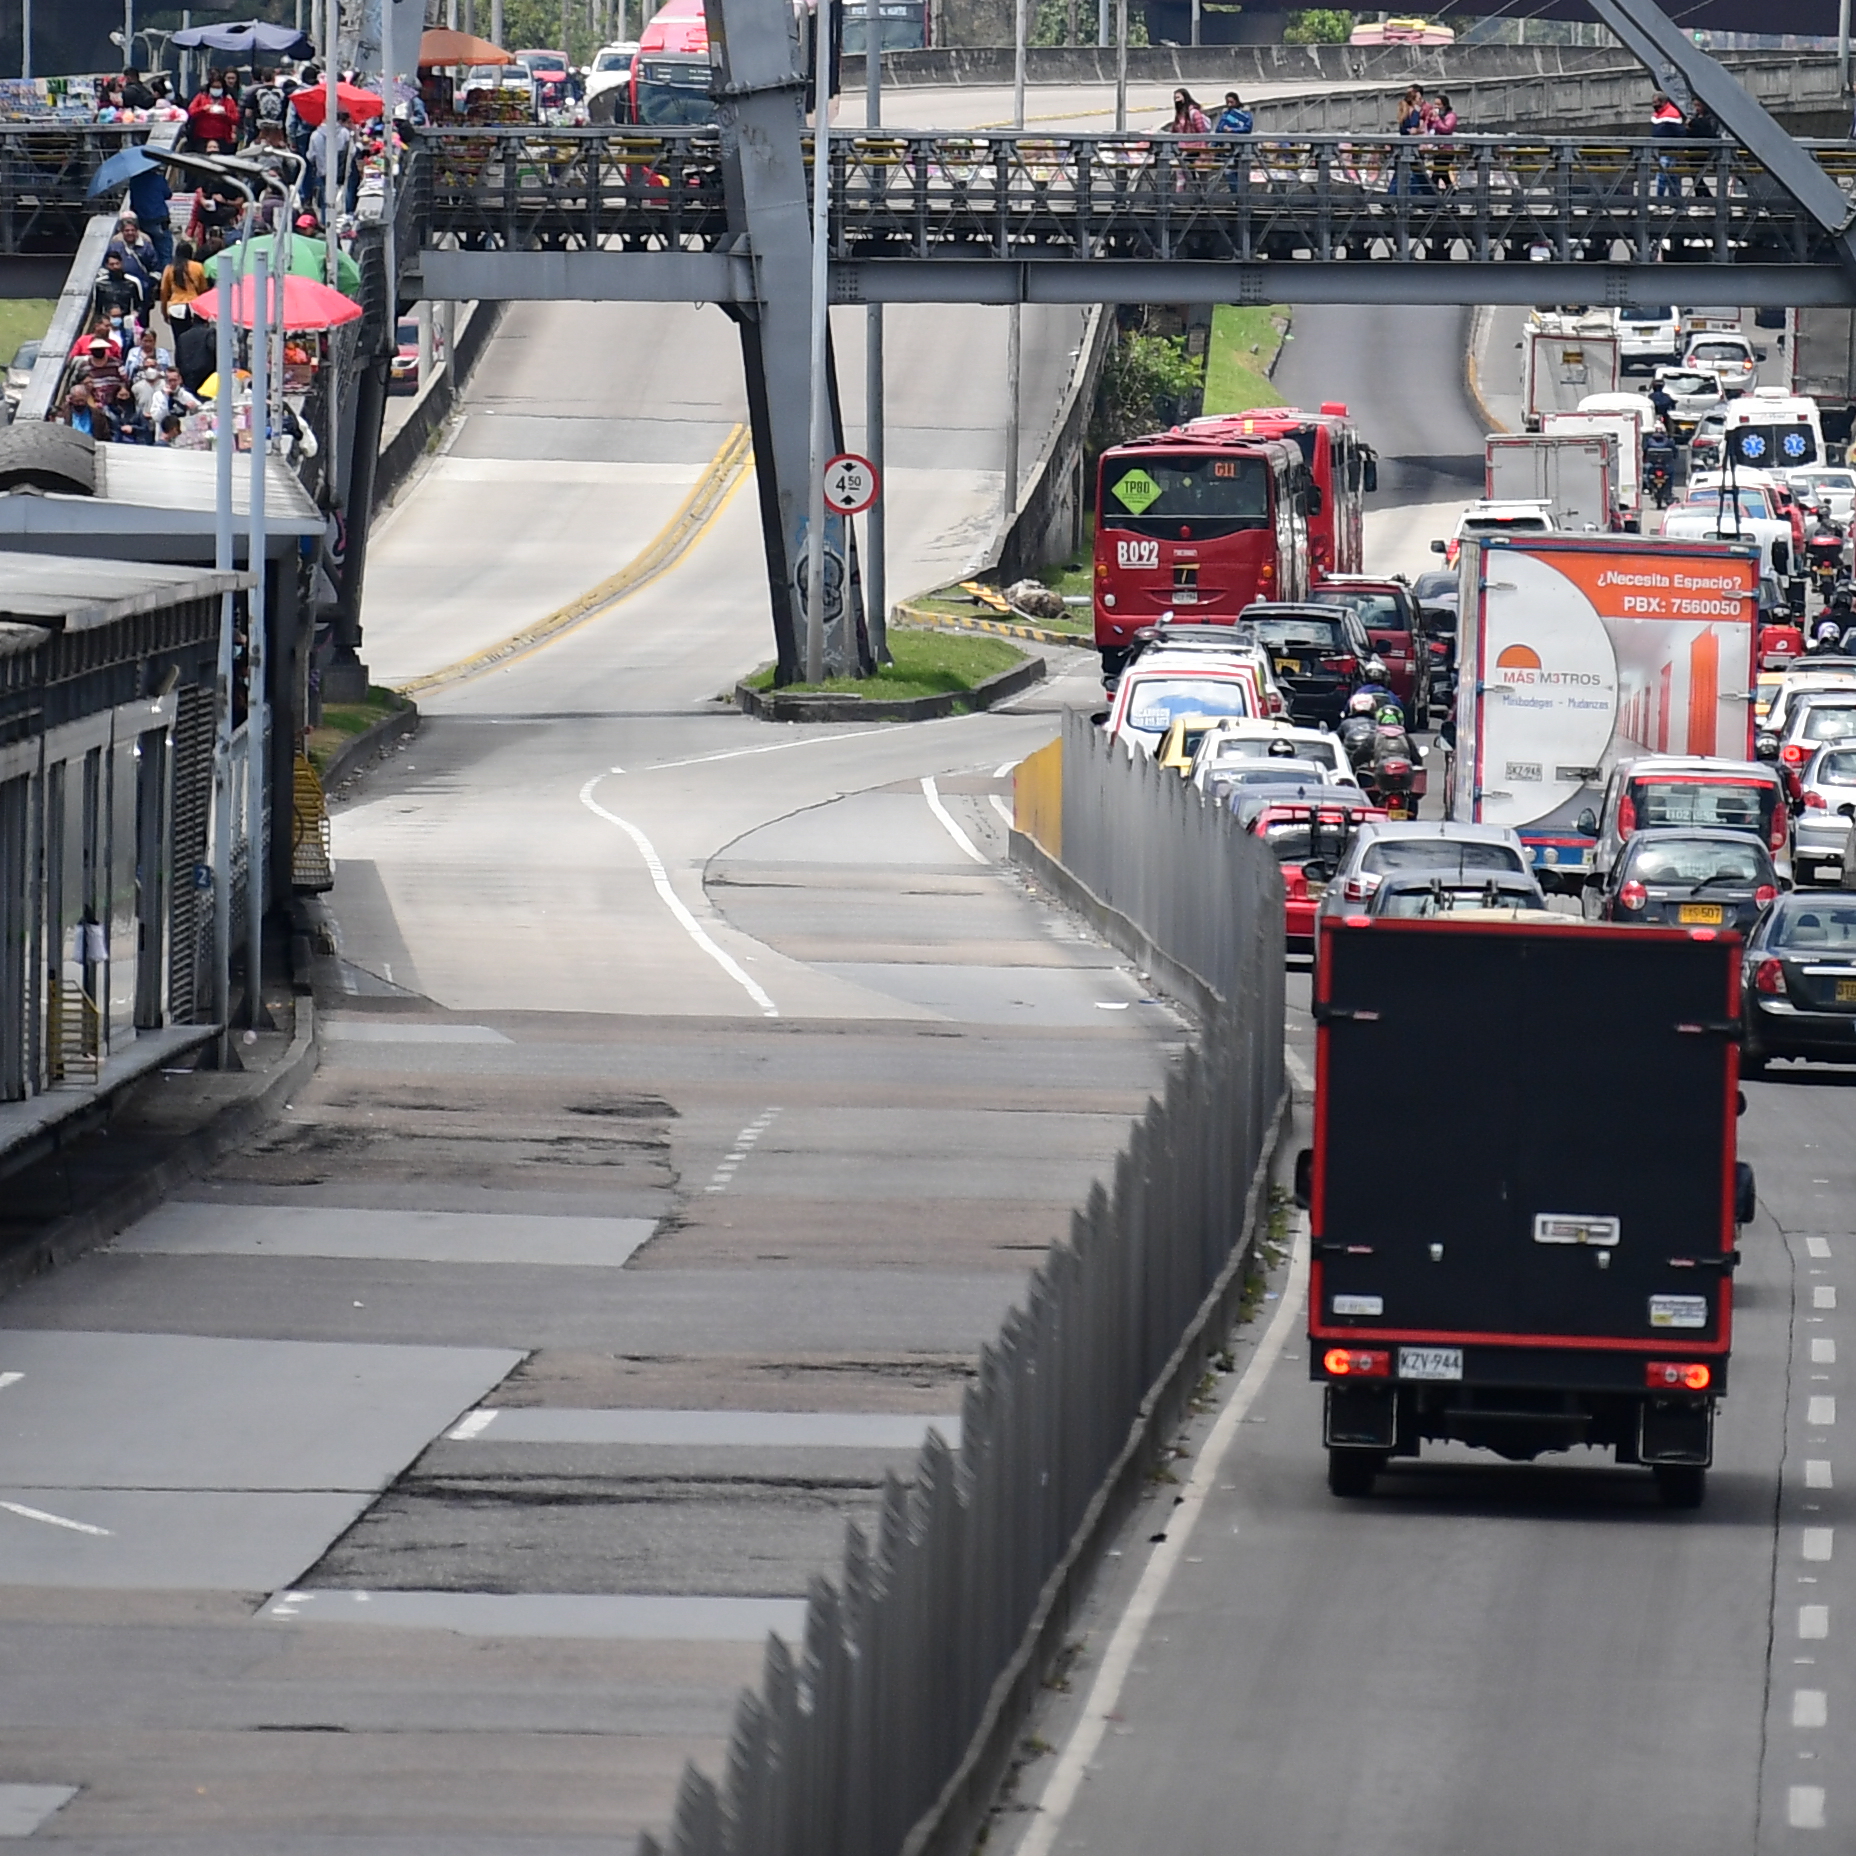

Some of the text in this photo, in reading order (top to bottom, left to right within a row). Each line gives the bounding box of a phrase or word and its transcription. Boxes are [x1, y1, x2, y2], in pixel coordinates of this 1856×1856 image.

[835, 476, 862, 491] 4 50
[1118, 541, 1159, 563] B092
[1597, 571, 1742, 591] ¿Necesita Espacio?
[1623, 596, 1741, 616] PBX: 7560050
[1503, 669, 1601, 686] MÁS M3TROS
[197, 868, 207, 885] 2
